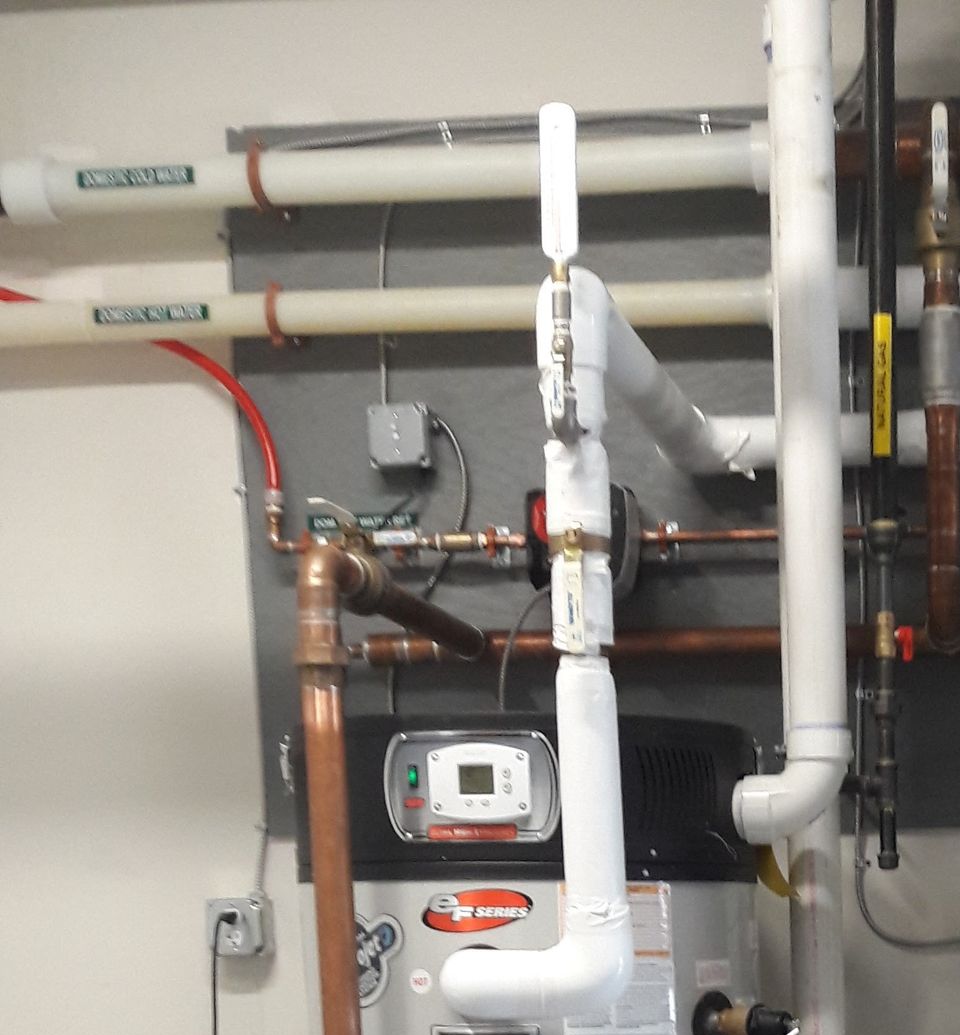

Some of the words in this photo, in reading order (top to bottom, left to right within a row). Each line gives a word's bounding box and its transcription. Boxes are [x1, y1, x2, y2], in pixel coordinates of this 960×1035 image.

[876, 371, 886, 429] NATURAL
[474, 906, 530, 919] SERIES
[411, 976, 428, 986] HOT
